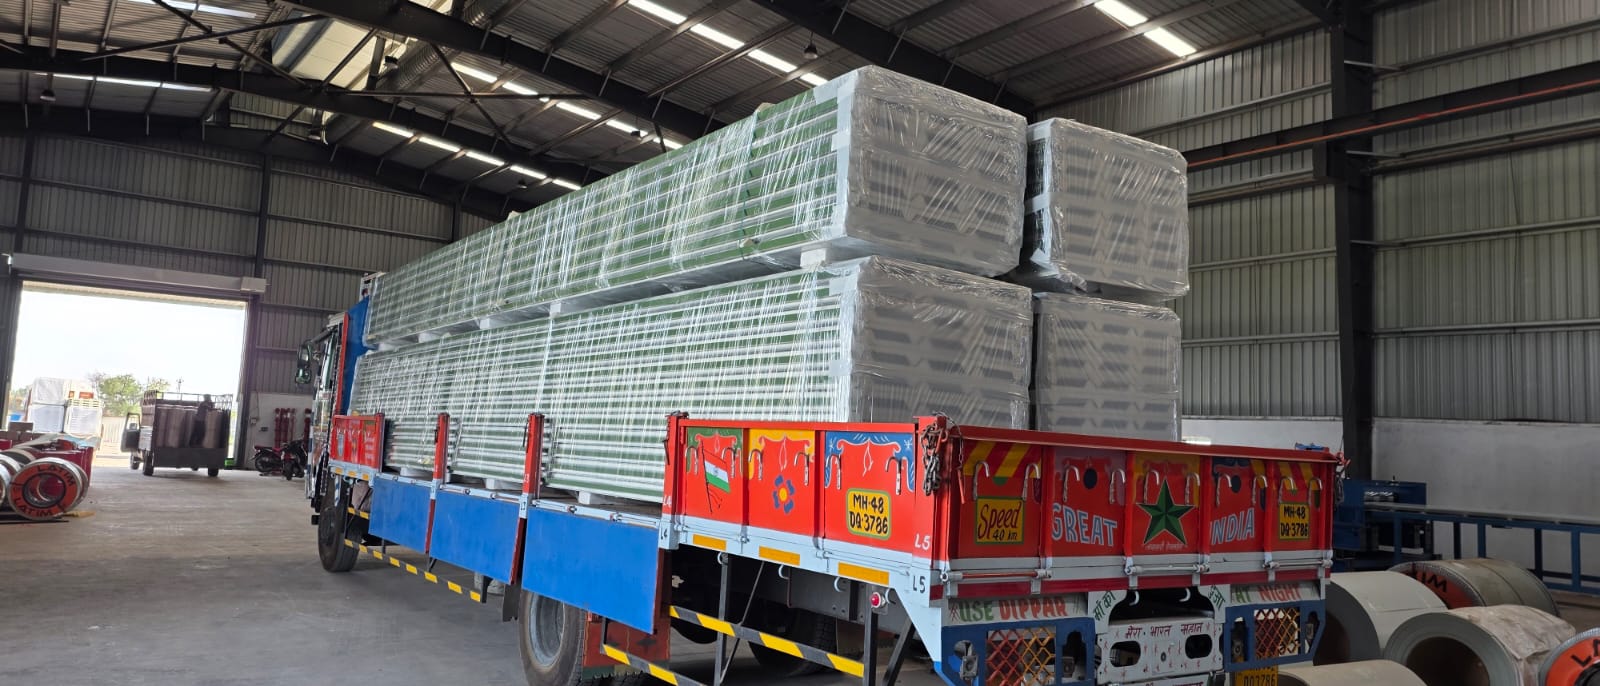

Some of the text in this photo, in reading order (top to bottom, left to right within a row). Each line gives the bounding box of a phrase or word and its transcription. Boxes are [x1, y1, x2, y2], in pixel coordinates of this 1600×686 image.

[978, 501, 1022, 540] Speed
[1052, 502, 1118, 546] GREAT
[914, 533, 931, 551] L5
[992, 529, 1005, 541] 40
[912, 575, 926, 593] L5
[1258, 583, 1302, 602] NIGHT
[960, 596, 1068, 622] USE DIPPAR
